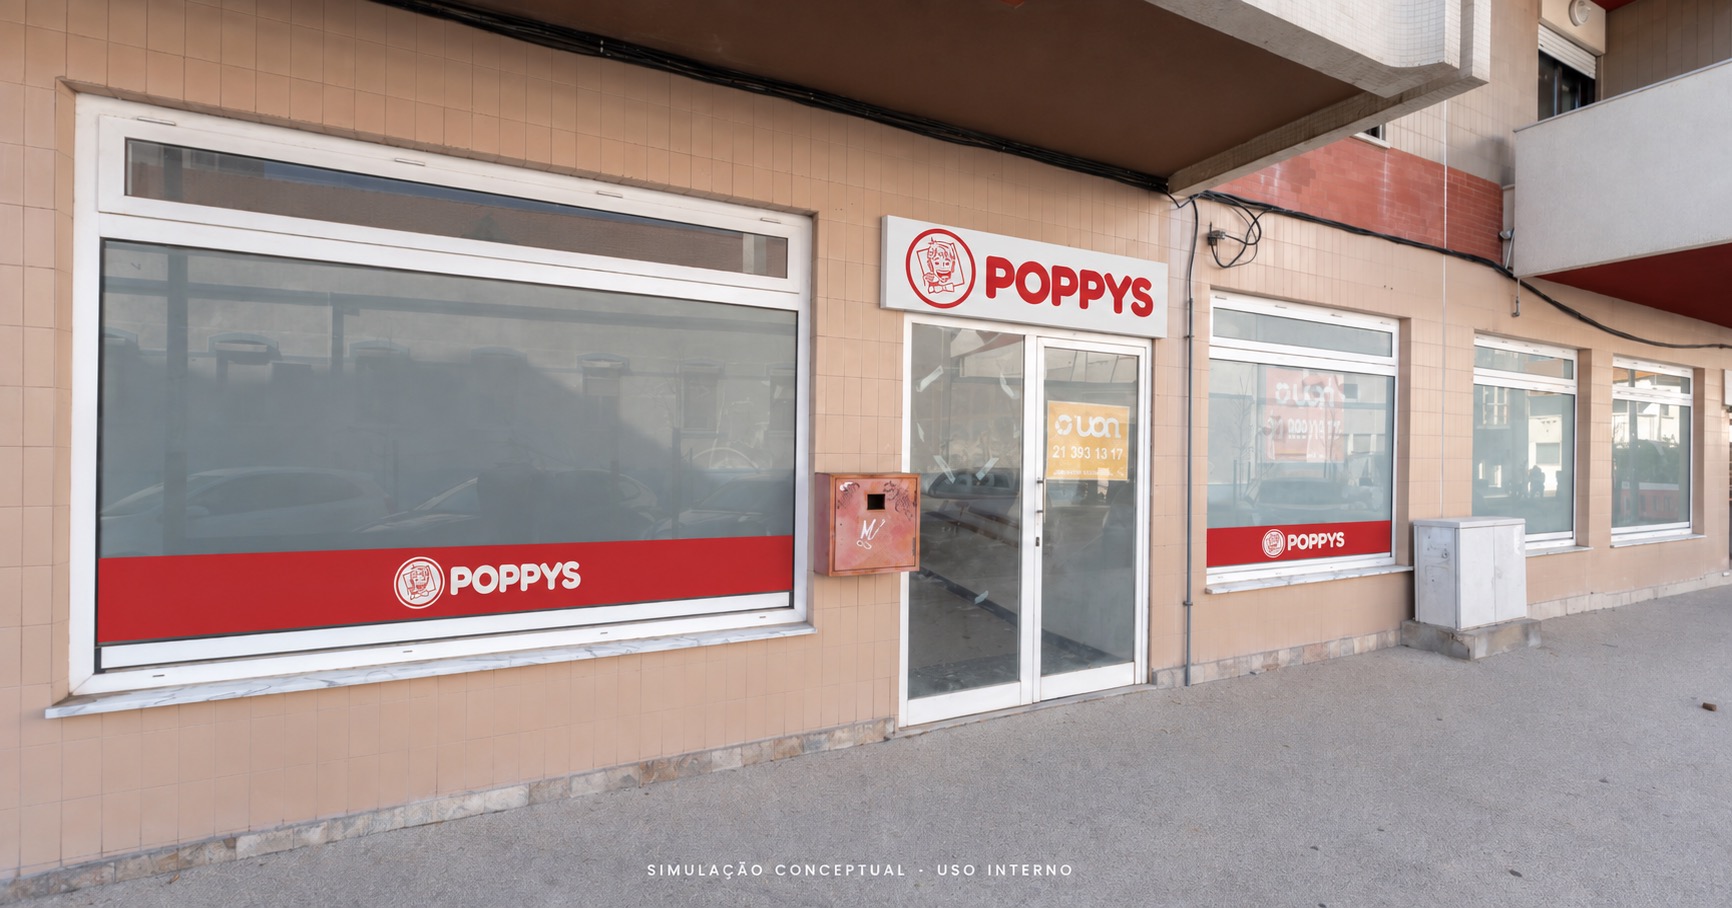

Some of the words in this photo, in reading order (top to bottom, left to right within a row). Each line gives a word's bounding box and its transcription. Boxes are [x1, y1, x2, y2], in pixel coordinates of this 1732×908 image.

[985, 255, 1154, 318] POPPYS
[1052, 445, 1066, 458] 21
[1070, 446, 1091, 459] 393
[1095, 447, 1108, 460] 13
[1110, 448, 1123, 460] 17
[1287, 531, 1345, 551] POPPYS
[450, 561, 581, 596] POPPYS
